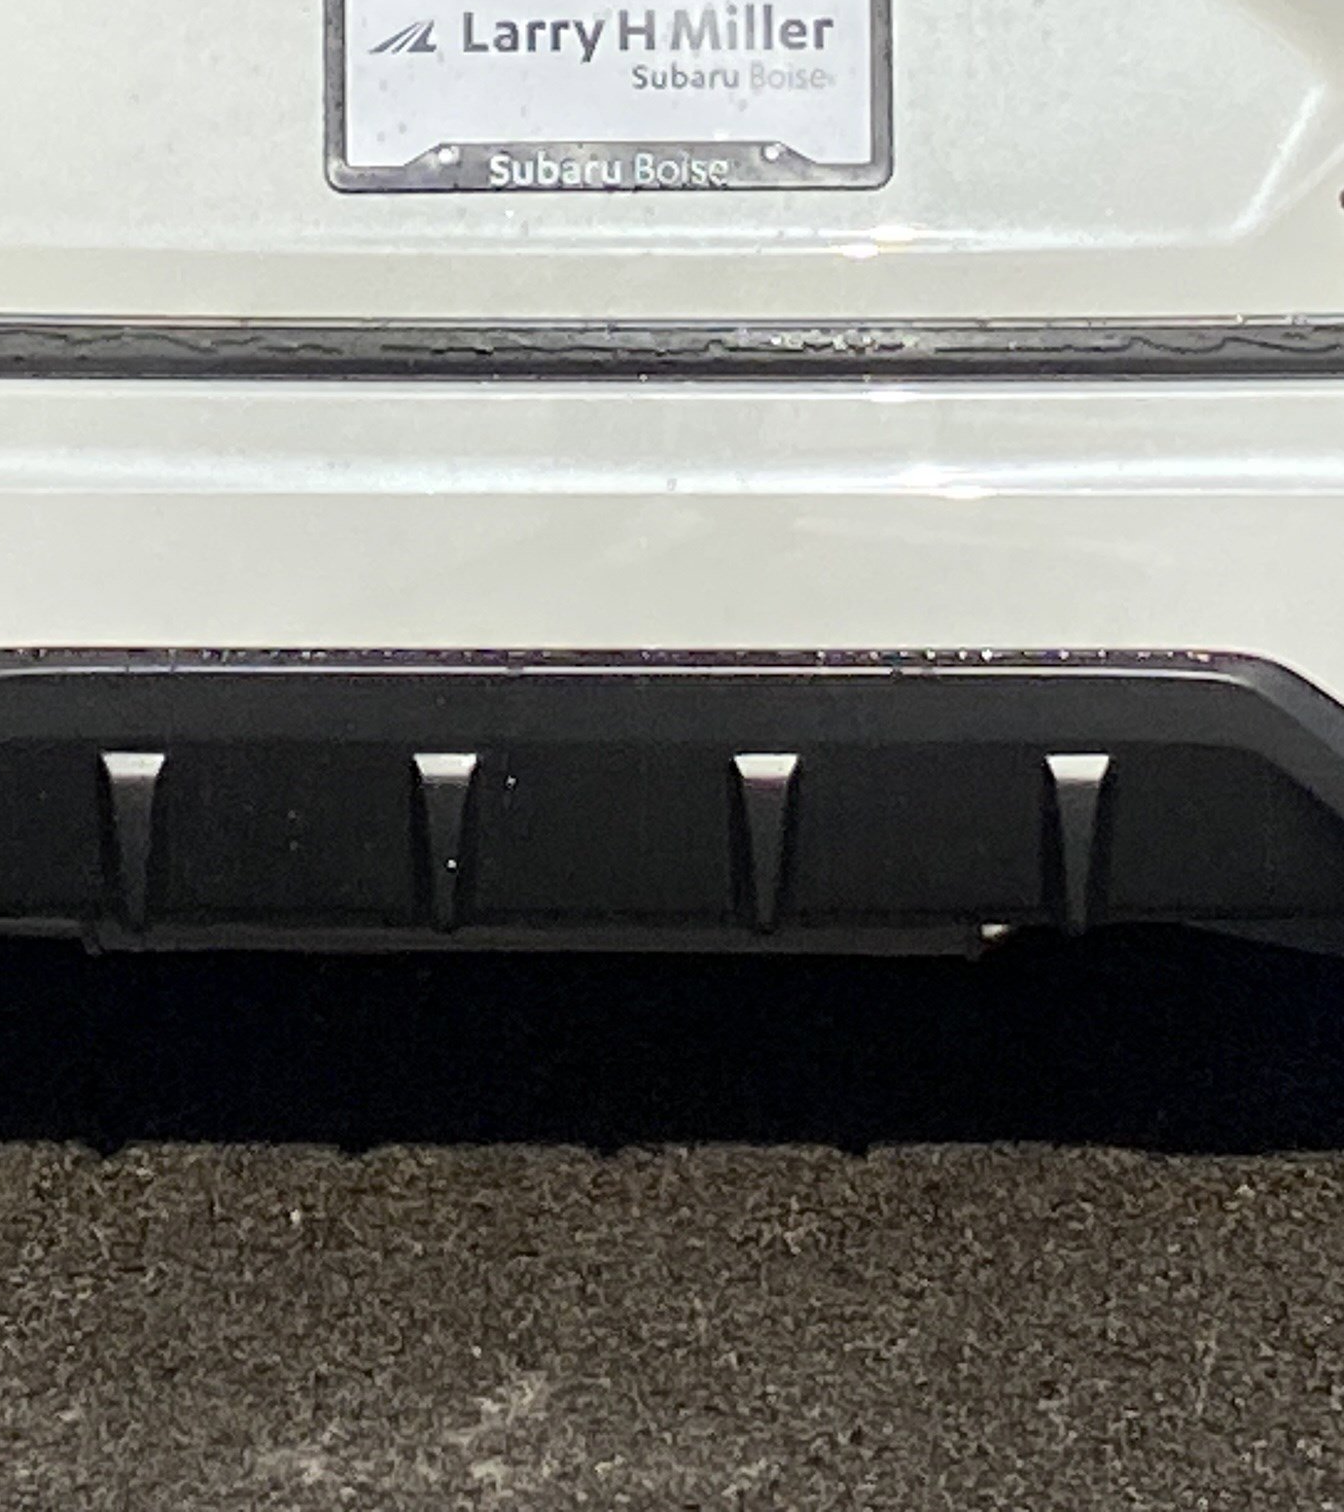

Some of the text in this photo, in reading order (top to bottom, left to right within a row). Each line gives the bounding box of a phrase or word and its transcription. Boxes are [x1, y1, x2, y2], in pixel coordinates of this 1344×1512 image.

[462, 3, 834, 63] Larry H Miller
[632, 62, 828, 90] Subaru Boise
[488, 152, 730, 188] Subaru Boise
